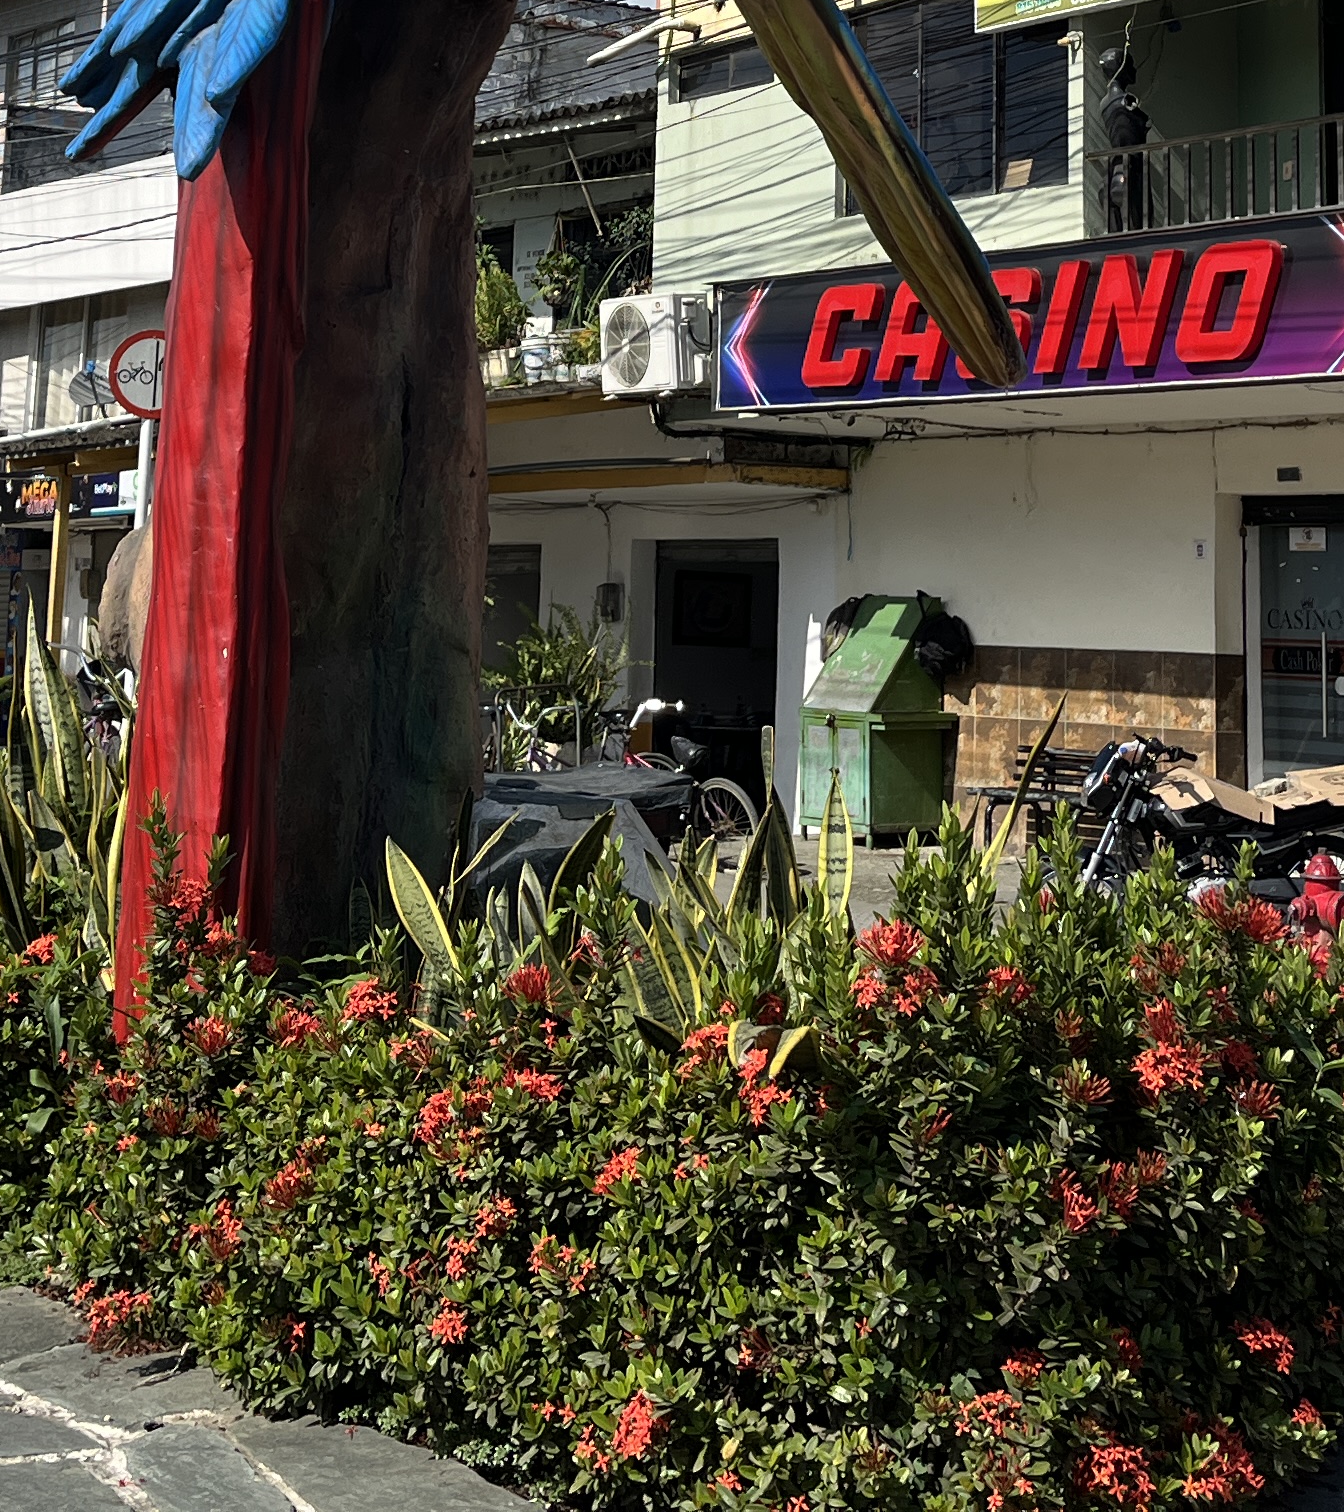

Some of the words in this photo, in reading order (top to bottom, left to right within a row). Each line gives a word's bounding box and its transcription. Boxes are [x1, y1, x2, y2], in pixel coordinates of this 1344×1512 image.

[1267, 608, 1344, 631] CASINO
[1280, 649, 1304, 671] Cash
[1306, 650, 1334, 673] Pokr
